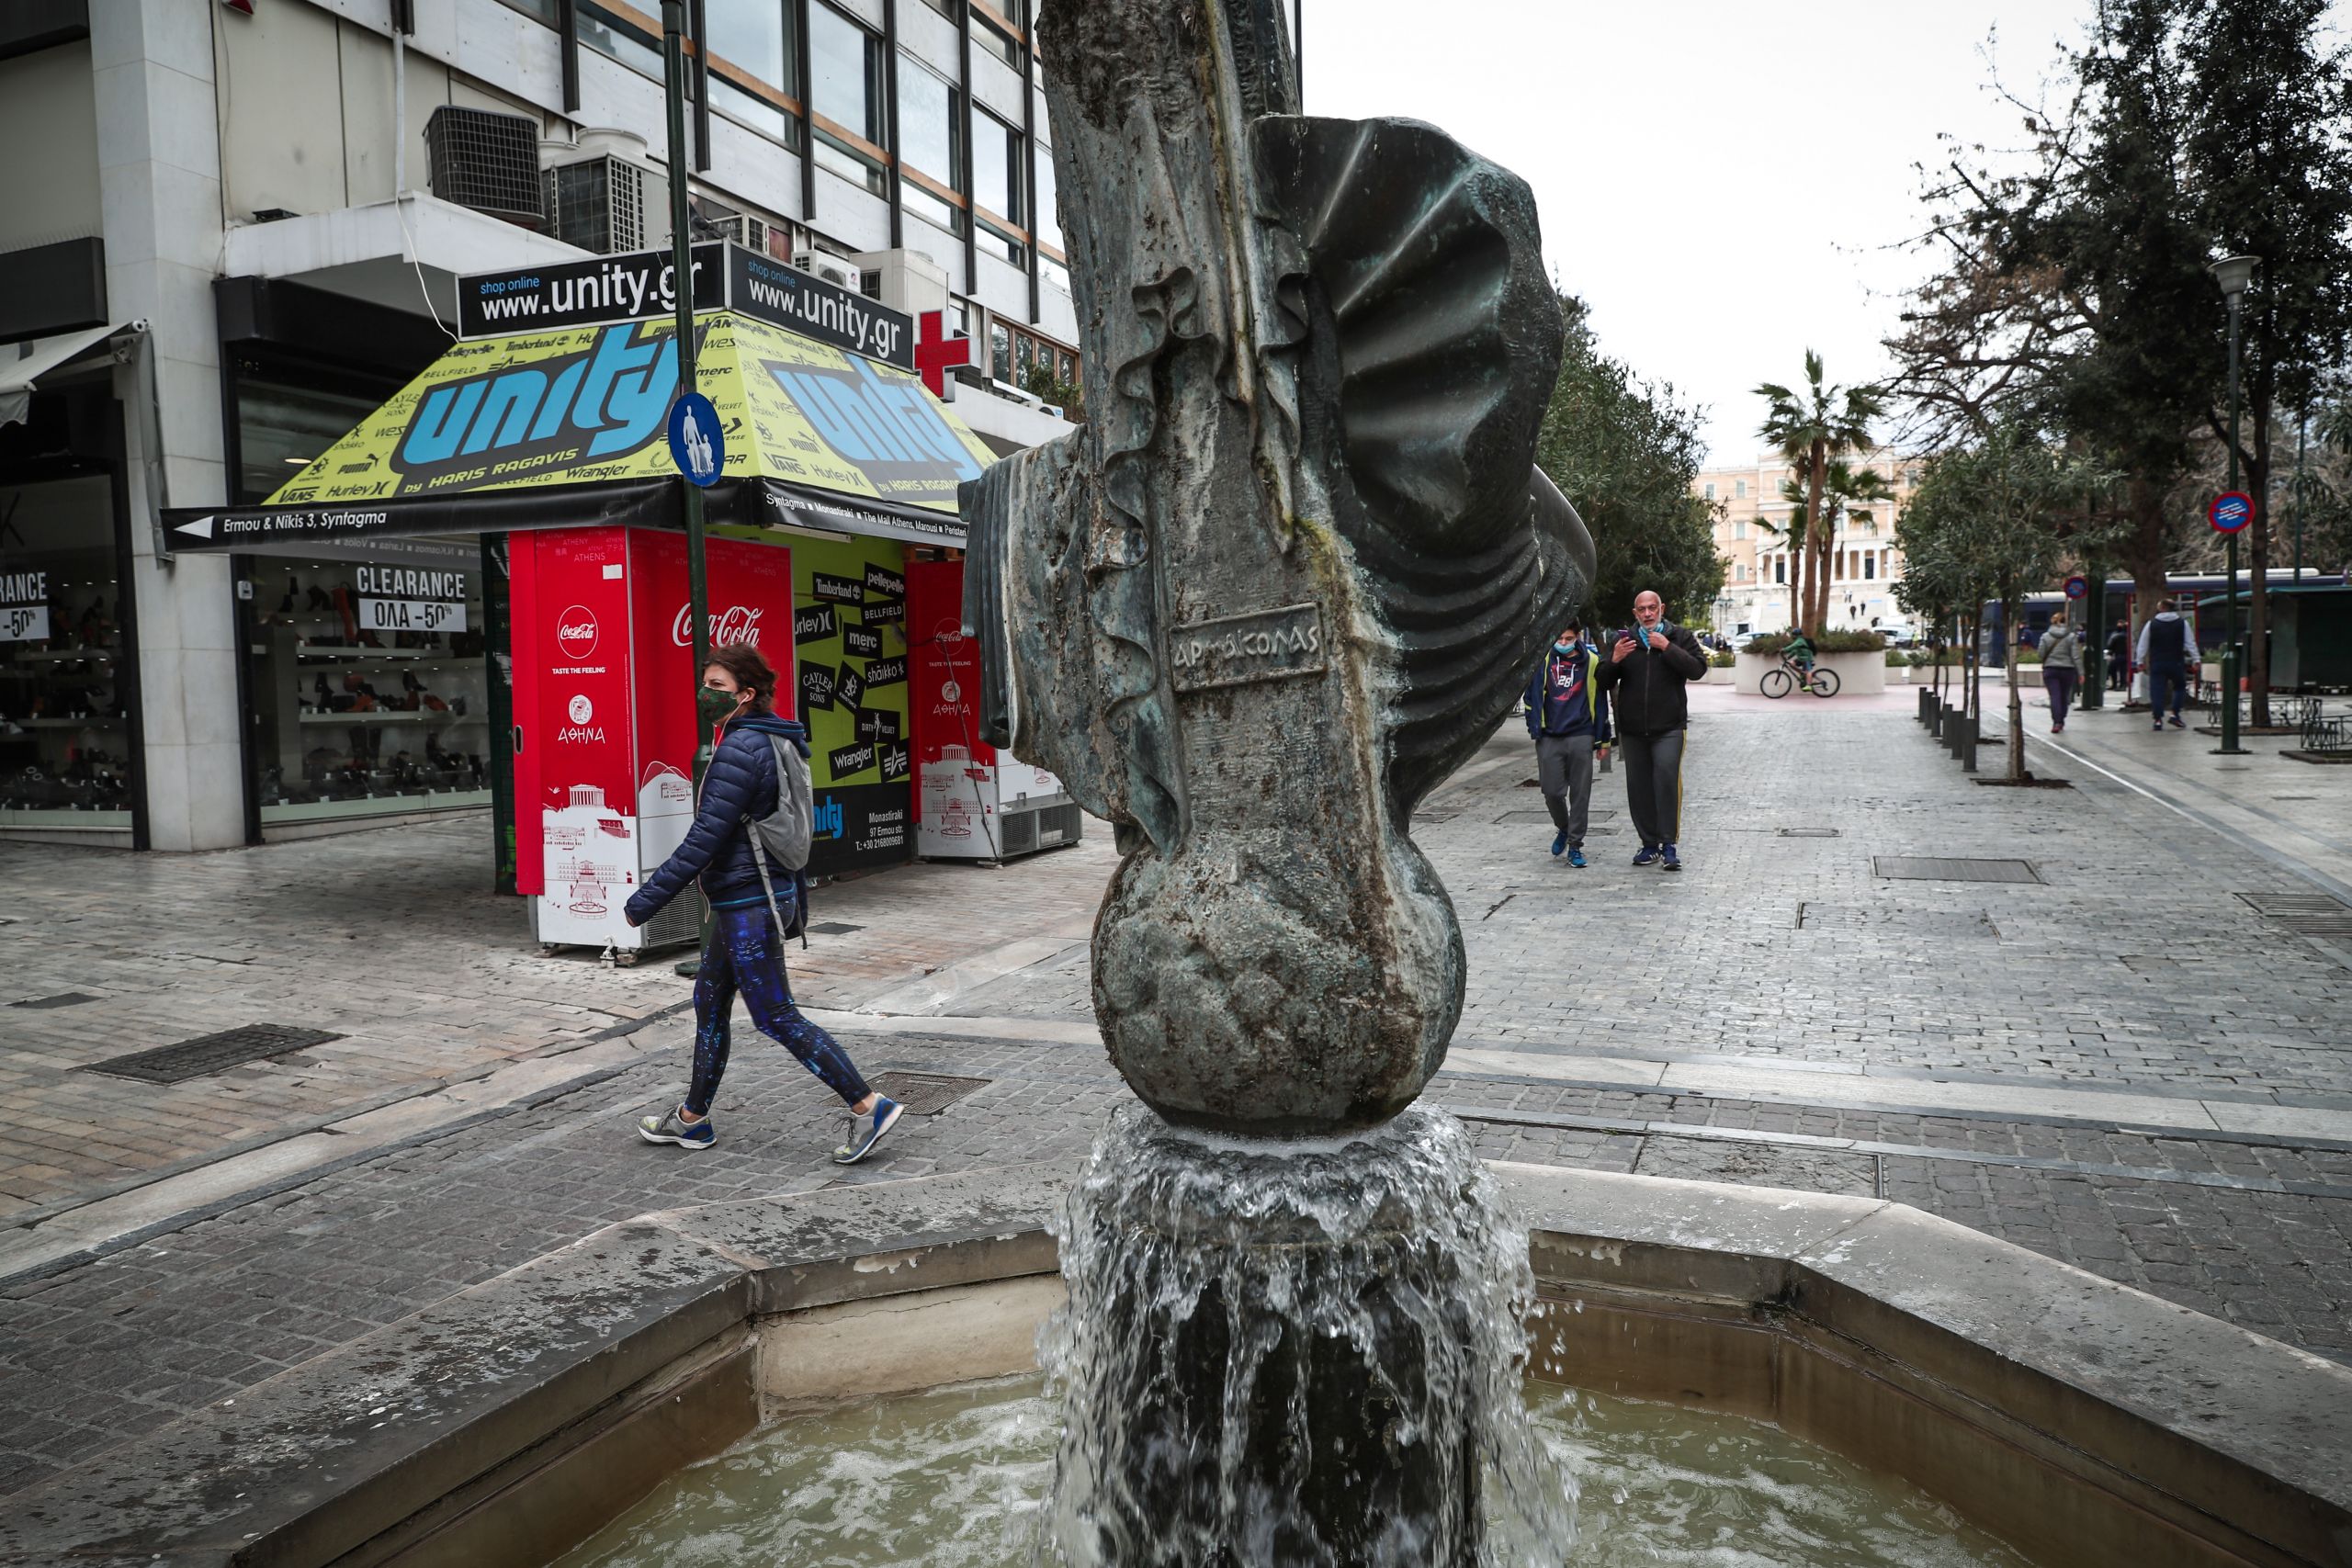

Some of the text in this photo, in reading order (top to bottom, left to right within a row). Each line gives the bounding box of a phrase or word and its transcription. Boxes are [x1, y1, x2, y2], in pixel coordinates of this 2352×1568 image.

[749, 260, 796, 288] shop online
[481, 276, 539, 294] shop online
[481, 261, 703, 321] www.unity.gr
[749, 277, 900, 359] www.unity.gr
[505, 338, 555, 352] Timberland
[424, 367, 477, 378] BELLFIELD
[695, 367, 733, 377] merc
[718, 401, 742, 412] VELVET
[404, 447, 580, 493] by HARIS RAGAVIS
[566, 464, 630, 480] Wrangler
[763, 452, 807, 475] VANS
[813, 463, 851, 484] Hurley
[278, 486, 320, 502] VANS
[325, 483, 371, 497] Hurley
[876, 482, 891, 492] by
[765, 492, 806, 511] Syntagma
[815, 502, 854, 519] Monastiraki
[863, 511, 876, 523] The
[877, 513, 890, 525] Mall
[892, 516, 914, 530] Athens,
[915, 520, 938, 533] Marousi
[223, 511, 387, 533] Ermou & Nikis 3, Syntagma
[574, 552, 605, 562] ATHENS
[356, 567, 466, 598] CLEARANCE
[816, 578, 852, 598] Timberland
[867, 572, 905, 593] pellepelle
[865, 606, 902, 619] BELLFIELD
[673, 602, 763, 649] Coa-Cola
[849, 632, 877, 649] merc
[802, 671, 833, 694] CAYLER
[1557, 675, 1572, 688] 28
[809, 692, 825, 703] SONS
[834, 747, 873, 769] Wrangler
[868, 809, 903, 824] Monastiraki
[869, 828, 877, 837] 97
[877, 826, 895, 837] Ermou
[863, 840, 874, 850] +30
